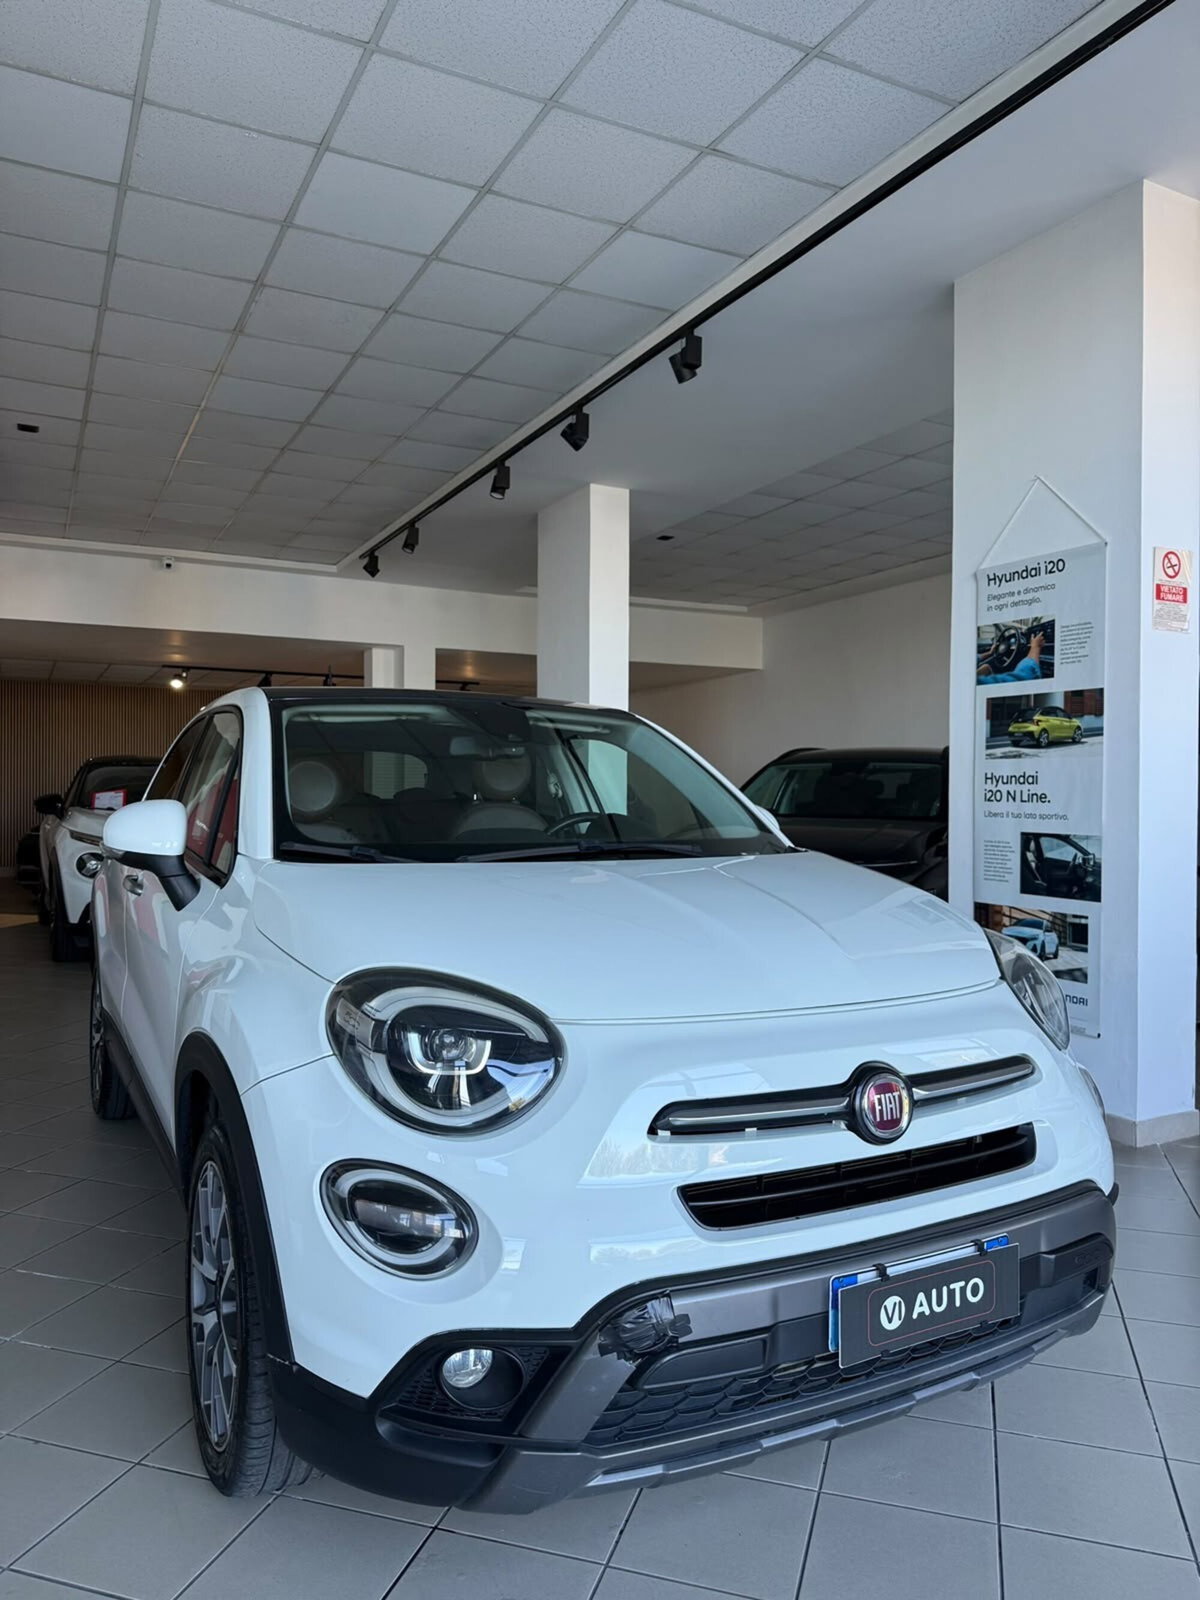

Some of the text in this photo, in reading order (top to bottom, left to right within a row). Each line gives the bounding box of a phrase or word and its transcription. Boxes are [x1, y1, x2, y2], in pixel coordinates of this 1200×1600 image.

[986, 558, 1066, 588] Hyundai i20
[987, 590, 1015, 602] Elegante
[1022, 583, 1056, 595] dinamica
[1160, 585, 1184, 595] VIETATO
[1160, 592, 1184, 602] FUMARE
[987, 596, 1042, 612] in ogni dettaglio.
[984, 771, 1038, 788] Hyundai
[984, 788, 1051, 804] i20 N Line.
[984, 810, 1069, 821] Libera il tuo lato sportivo.
[1065, 994, 1088, 1006] NDAI
[874, 1091, 900, 1122] FIAT
[912, 1277, 985, 1320] AUTO
